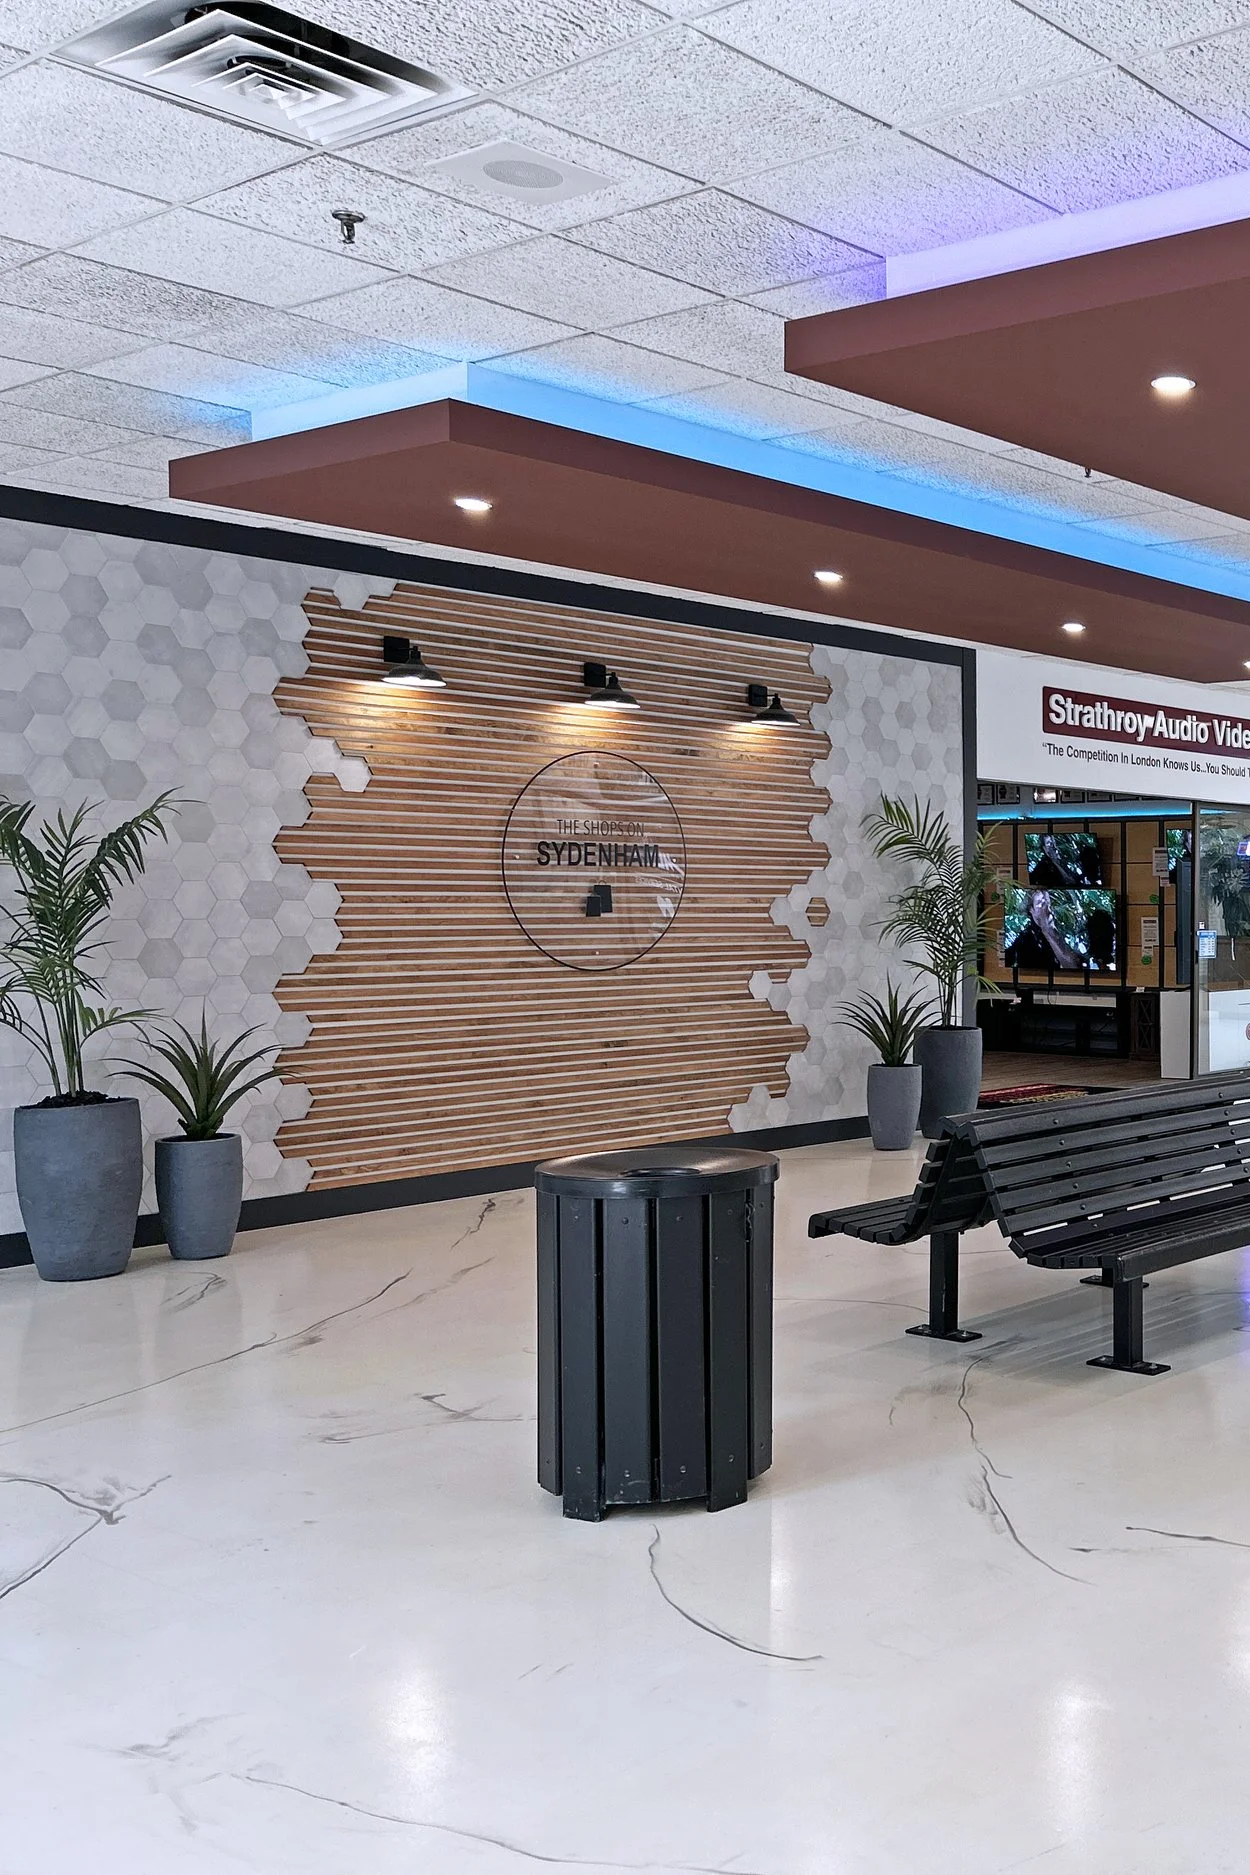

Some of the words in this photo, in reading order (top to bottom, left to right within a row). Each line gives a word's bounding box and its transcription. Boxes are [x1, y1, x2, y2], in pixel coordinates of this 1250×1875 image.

[1049, 693, 1149, 742] Strathroy
[1152, 709, 1210, 744] Audio
[1066, 745, 1119, 763] Competition
[1120, 751, 1129, 764] In
[1131, 755, 1161, 768] London
[1163, 757, 1189, 771] Knows
[1221, 764, 1246, 778] Should
[556, 819, 580, 835] THE
[583, 819, 624, 837] SHOPS
[627, 821, 645, 837] ON
[536, 840, 659, 868] SYDENHAM
